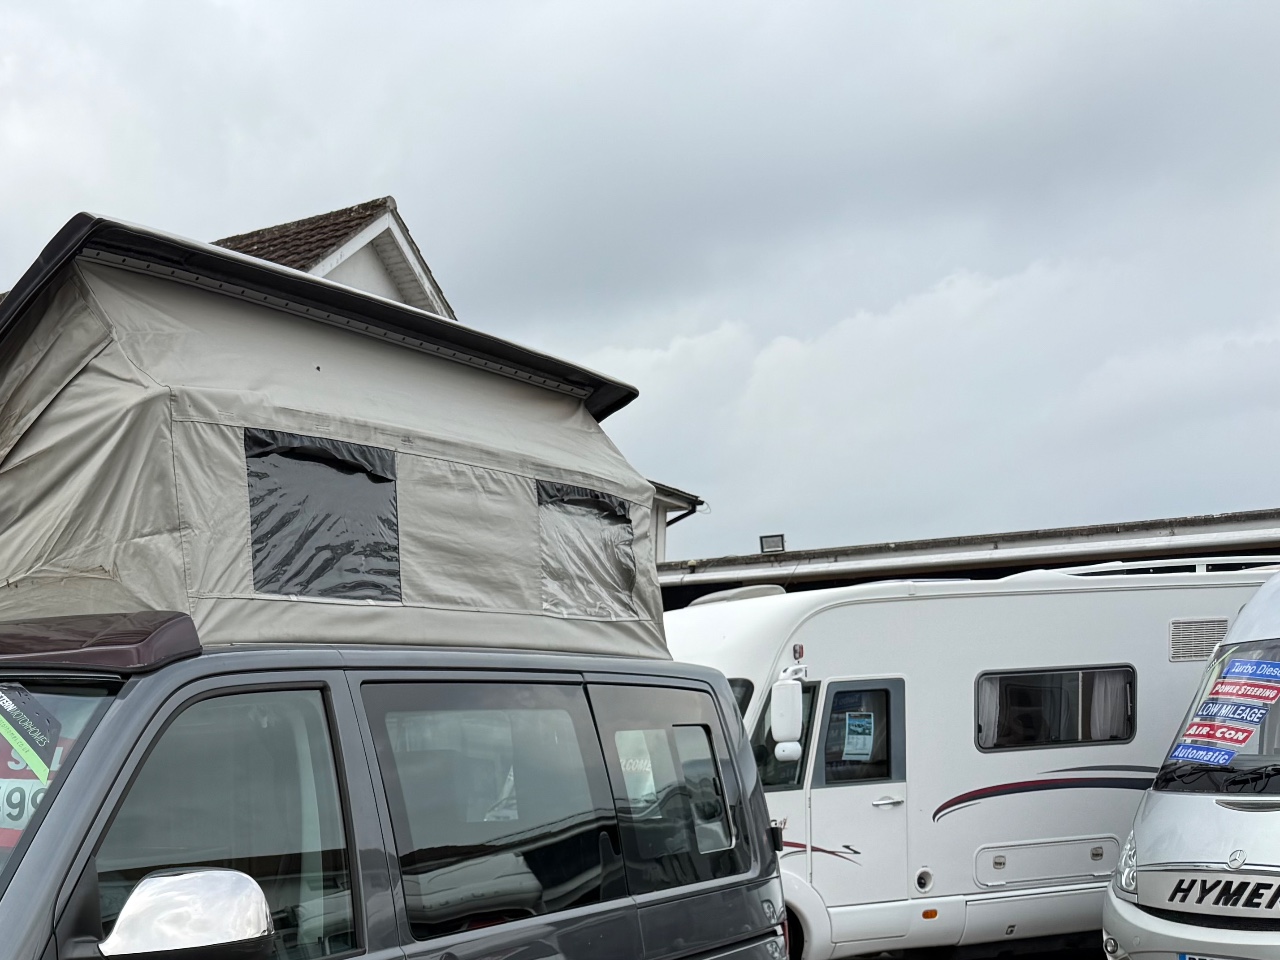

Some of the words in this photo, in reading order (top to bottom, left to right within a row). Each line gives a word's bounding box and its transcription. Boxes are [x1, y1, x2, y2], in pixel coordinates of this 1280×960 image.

[1232, 663, 1256, 673] Turbo
[1213, 684, 1240, 694] POWER
[1238, 685, 1277, 698] STEERING
[1198, 702, 1221, 716] LOW
[1219, 705, 1267, 722] MILEAGE
[1186, 725, 1248, 741] AIR-CON
[1172, 745, 1229, 764] Automatic
